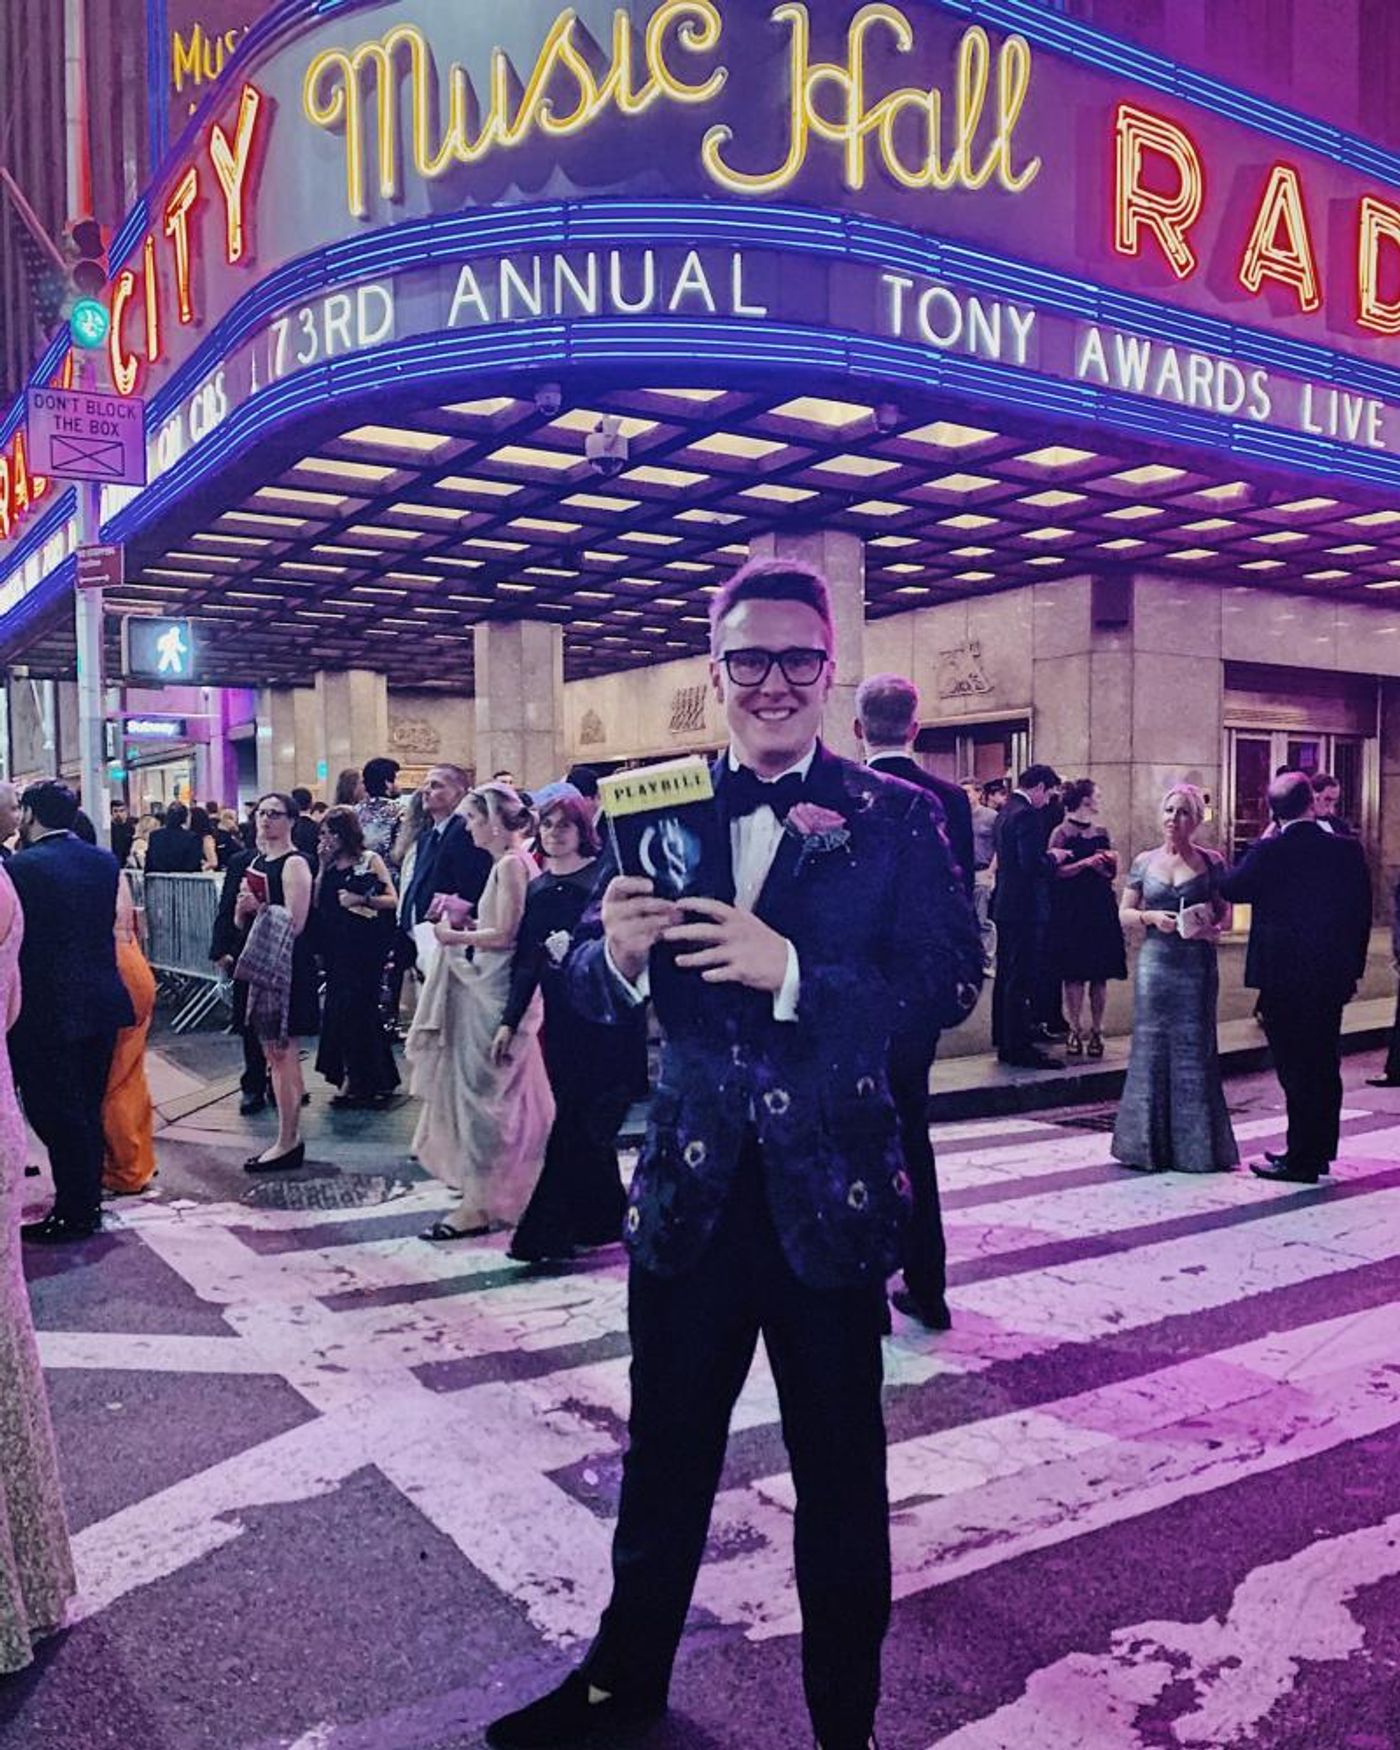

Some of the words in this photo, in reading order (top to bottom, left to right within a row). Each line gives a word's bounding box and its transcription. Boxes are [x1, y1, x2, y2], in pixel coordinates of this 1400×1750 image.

[304, 0, 728, 217] Music
[701, 2, 1040, 193] Hall
[110, 84, 260, 395] CITY
[269, 285, 395, 378] 73RD
[447, 250, 767, 327] ANNUAL
[881, 274, 1036, 366] TONY
[1078, 327, 1272, 421] AWARDS
[1303, 383, 1386, 448] LIVE
[34, 393, 80, 412] DON'T
[86, 399, 136, 421] BLOCK
[54, 414, 82, 433] THE
[89, 420, 120, 437] BOX
[613, 774, 704, 801] PLAYBILL
